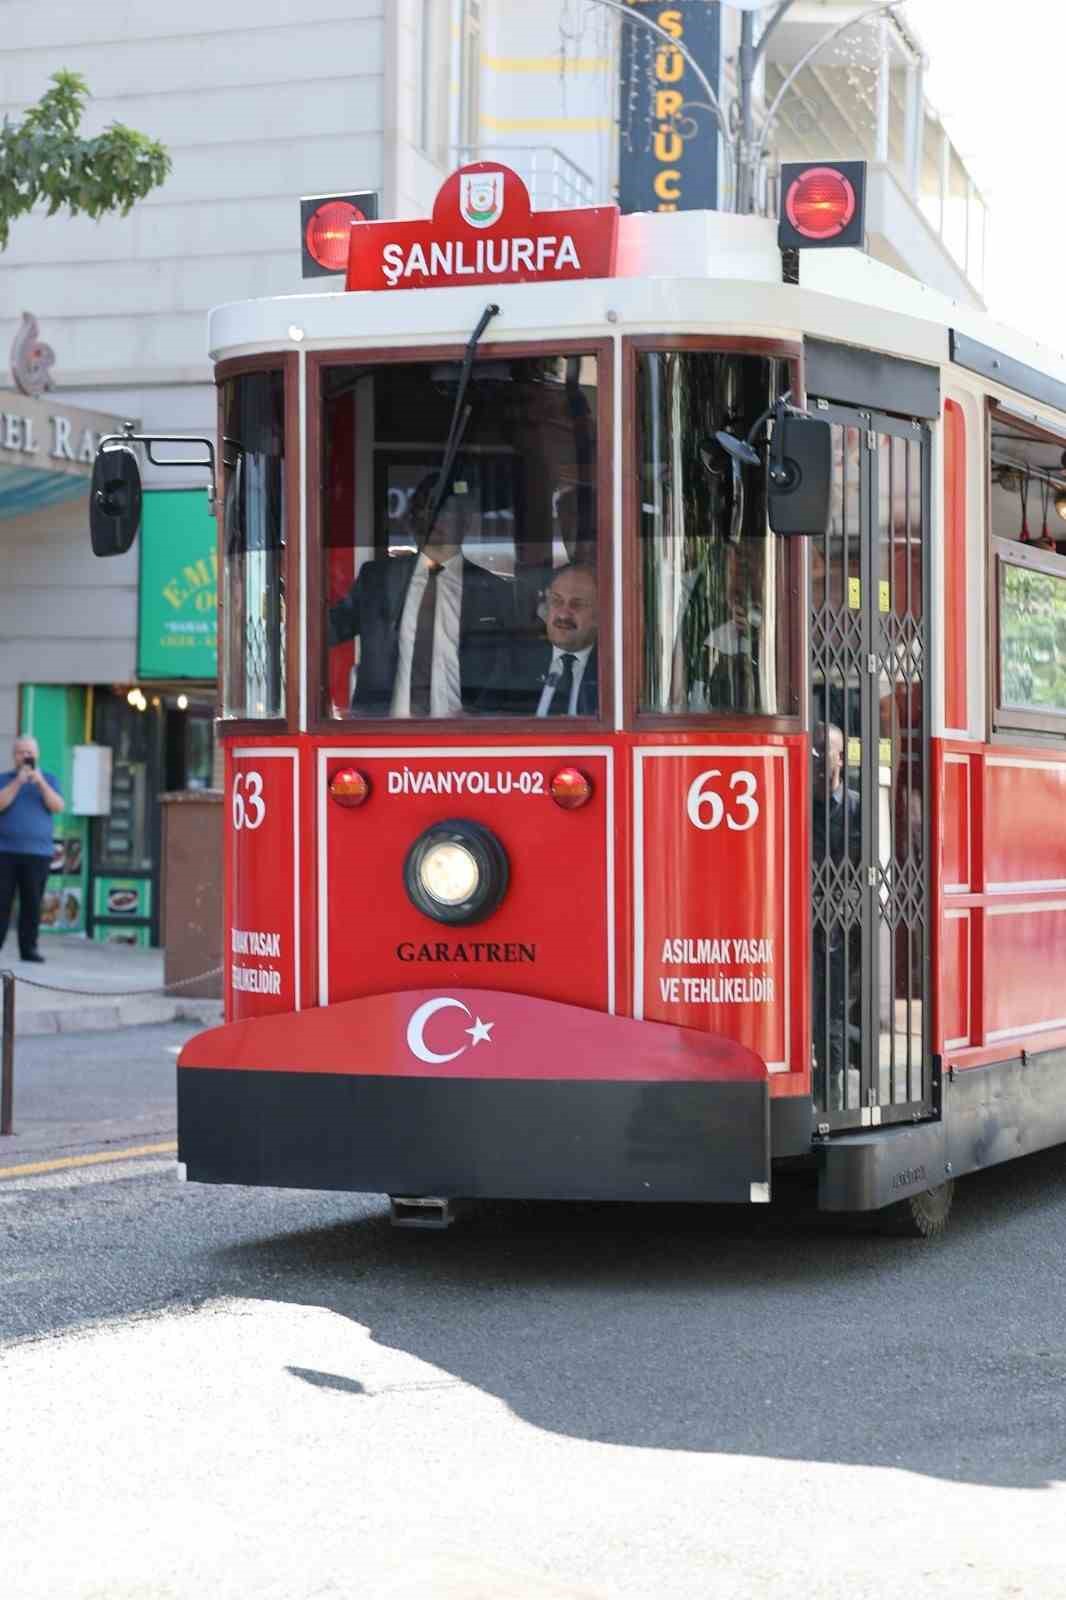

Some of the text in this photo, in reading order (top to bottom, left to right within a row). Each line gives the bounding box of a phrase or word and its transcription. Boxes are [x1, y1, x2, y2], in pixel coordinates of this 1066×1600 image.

[654, 9, 684, 212] SÜRÜC
[381, 235, 581, 286] ŞANLIURFA
[53, 416, 98, 463] RA
[232, 771, 266, 830] 63
[387, 766, 544, 795] DİVANYOLU-02
[687, 769, 760, 831] 63
[249, 932, 281, 958] YASAK
[396, 942, 537, 963] GARATREN
[661, 938, 774, 965] ASILMAK YASAK
[659, 971, 776, 1004] VE TEHLİKELİDİR
